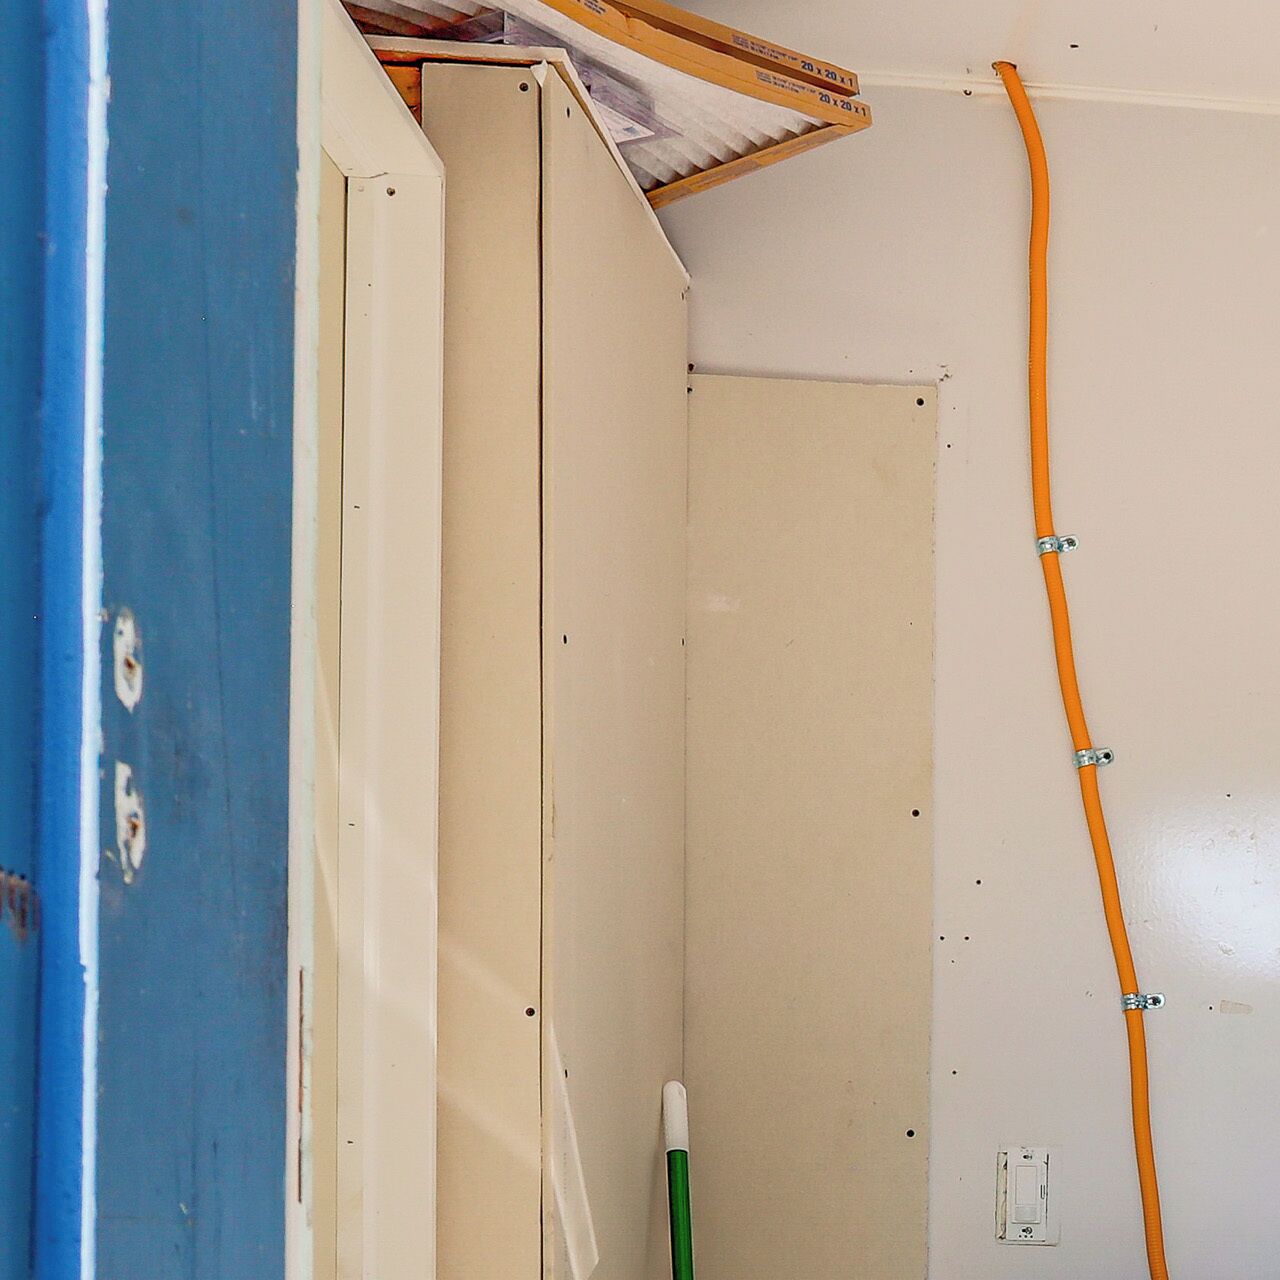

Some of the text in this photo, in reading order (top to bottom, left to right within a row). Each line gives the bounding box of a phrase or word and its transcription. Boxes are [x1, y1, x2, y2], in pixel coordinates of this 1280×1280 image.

[801, 60, 853, 87] 20 x 20 x 1
[819, 92, 866, 117] 20 x 20 x 1
